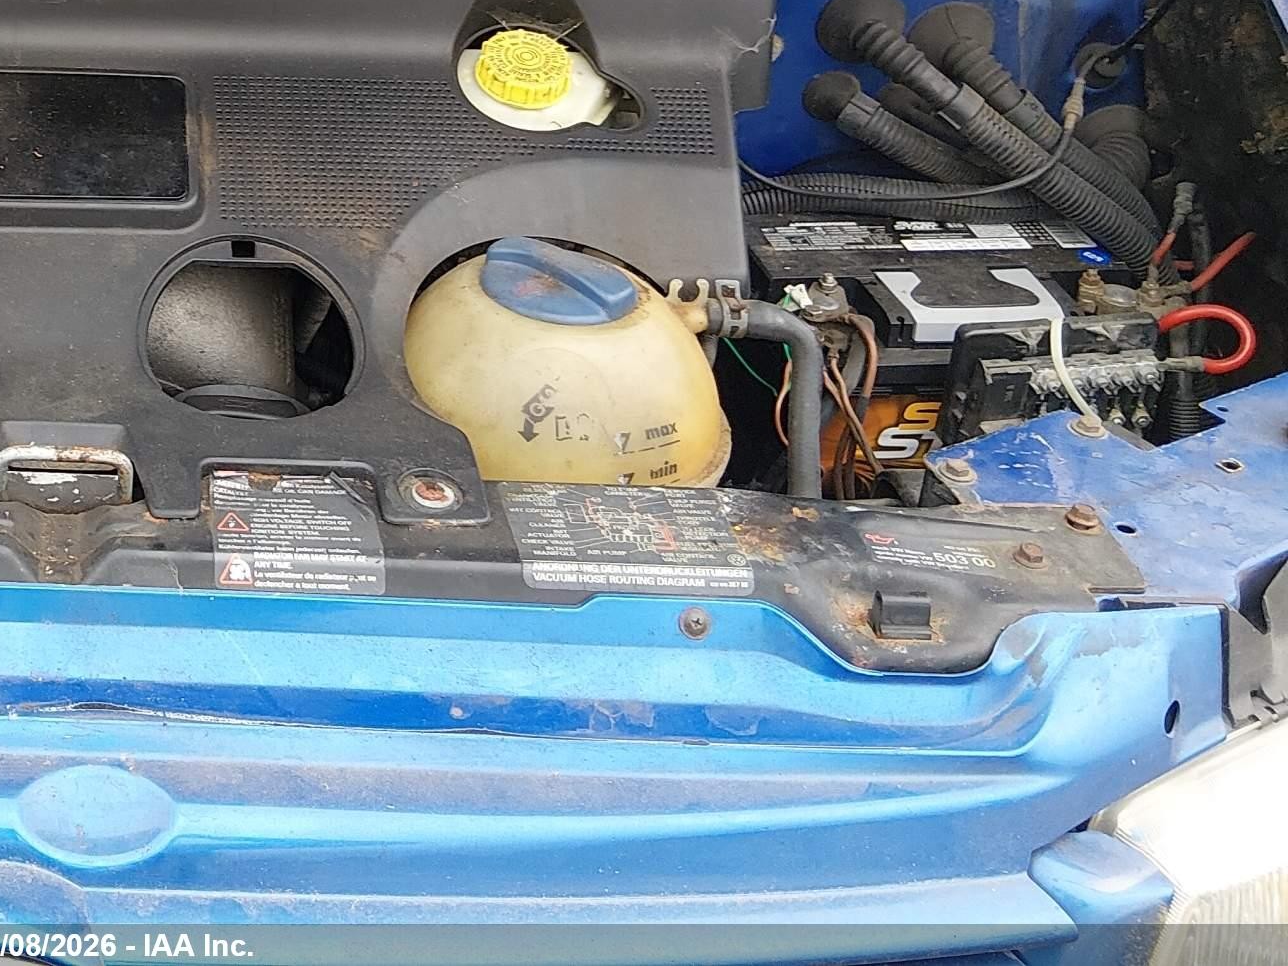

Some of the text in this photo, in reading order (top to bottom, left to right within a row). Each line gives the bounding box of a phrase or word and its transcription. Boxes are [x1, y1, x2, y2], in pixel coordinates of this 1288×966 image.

[644, 421, 679, 441] max
[650, 460, 678, 481] min
[330, 555, 355, 563] START
[932, 552, 969, 565] 503
[971, 556, 997, 569] 00
[600, 564, 621, 574] DER
[533, 572, 578, 583] VACUUM
[579, 574, 607, 584] HOSE
[608, 575, 653, 586] ROUTING
[654, 577, 705, 588] DIAGRAM
